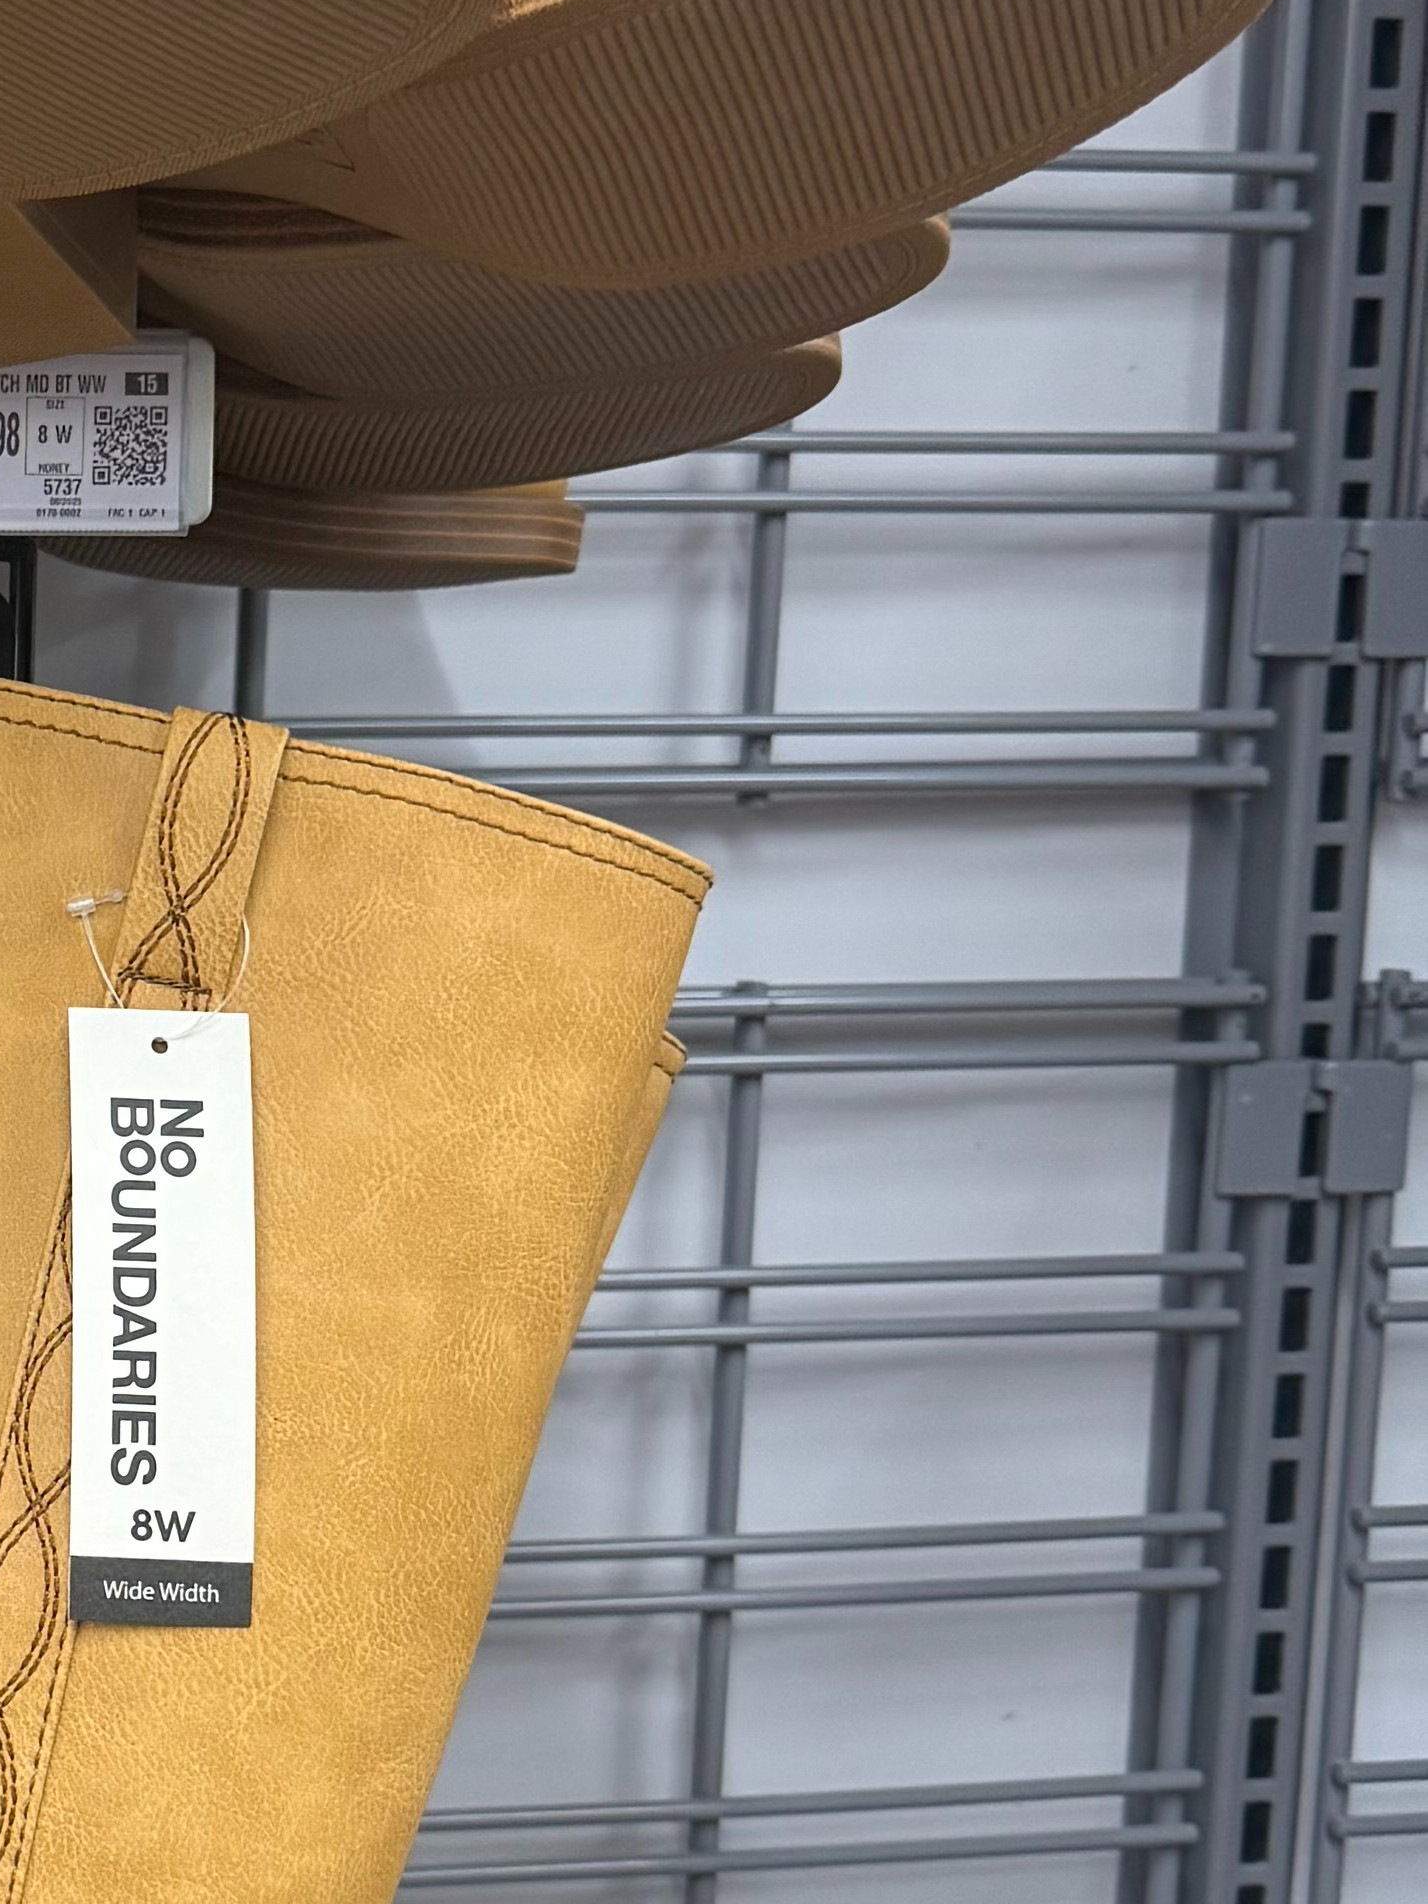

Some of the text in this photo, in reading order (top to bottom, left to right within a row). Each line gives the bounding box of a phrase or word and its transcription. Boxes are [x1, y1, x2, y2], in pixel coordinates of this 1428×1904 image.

[26, 374, 49, 393] MD
[55, 375, 73, 394] BT
[77, 375, 107, 394] WW
[136, 375, 158, 393] 15
[46, 399, 65, 410] SIZE
[37, 424, 73, 444] 8 W
[38, 463, 70, 474] HONEY
[43, 478, 82, 496] 5737
[109, 1096, 157, 1487] BOUNDARIES
[129, 1508, 196, 1543] 8W
[103, 1579, 220, 1604] Wide Width
